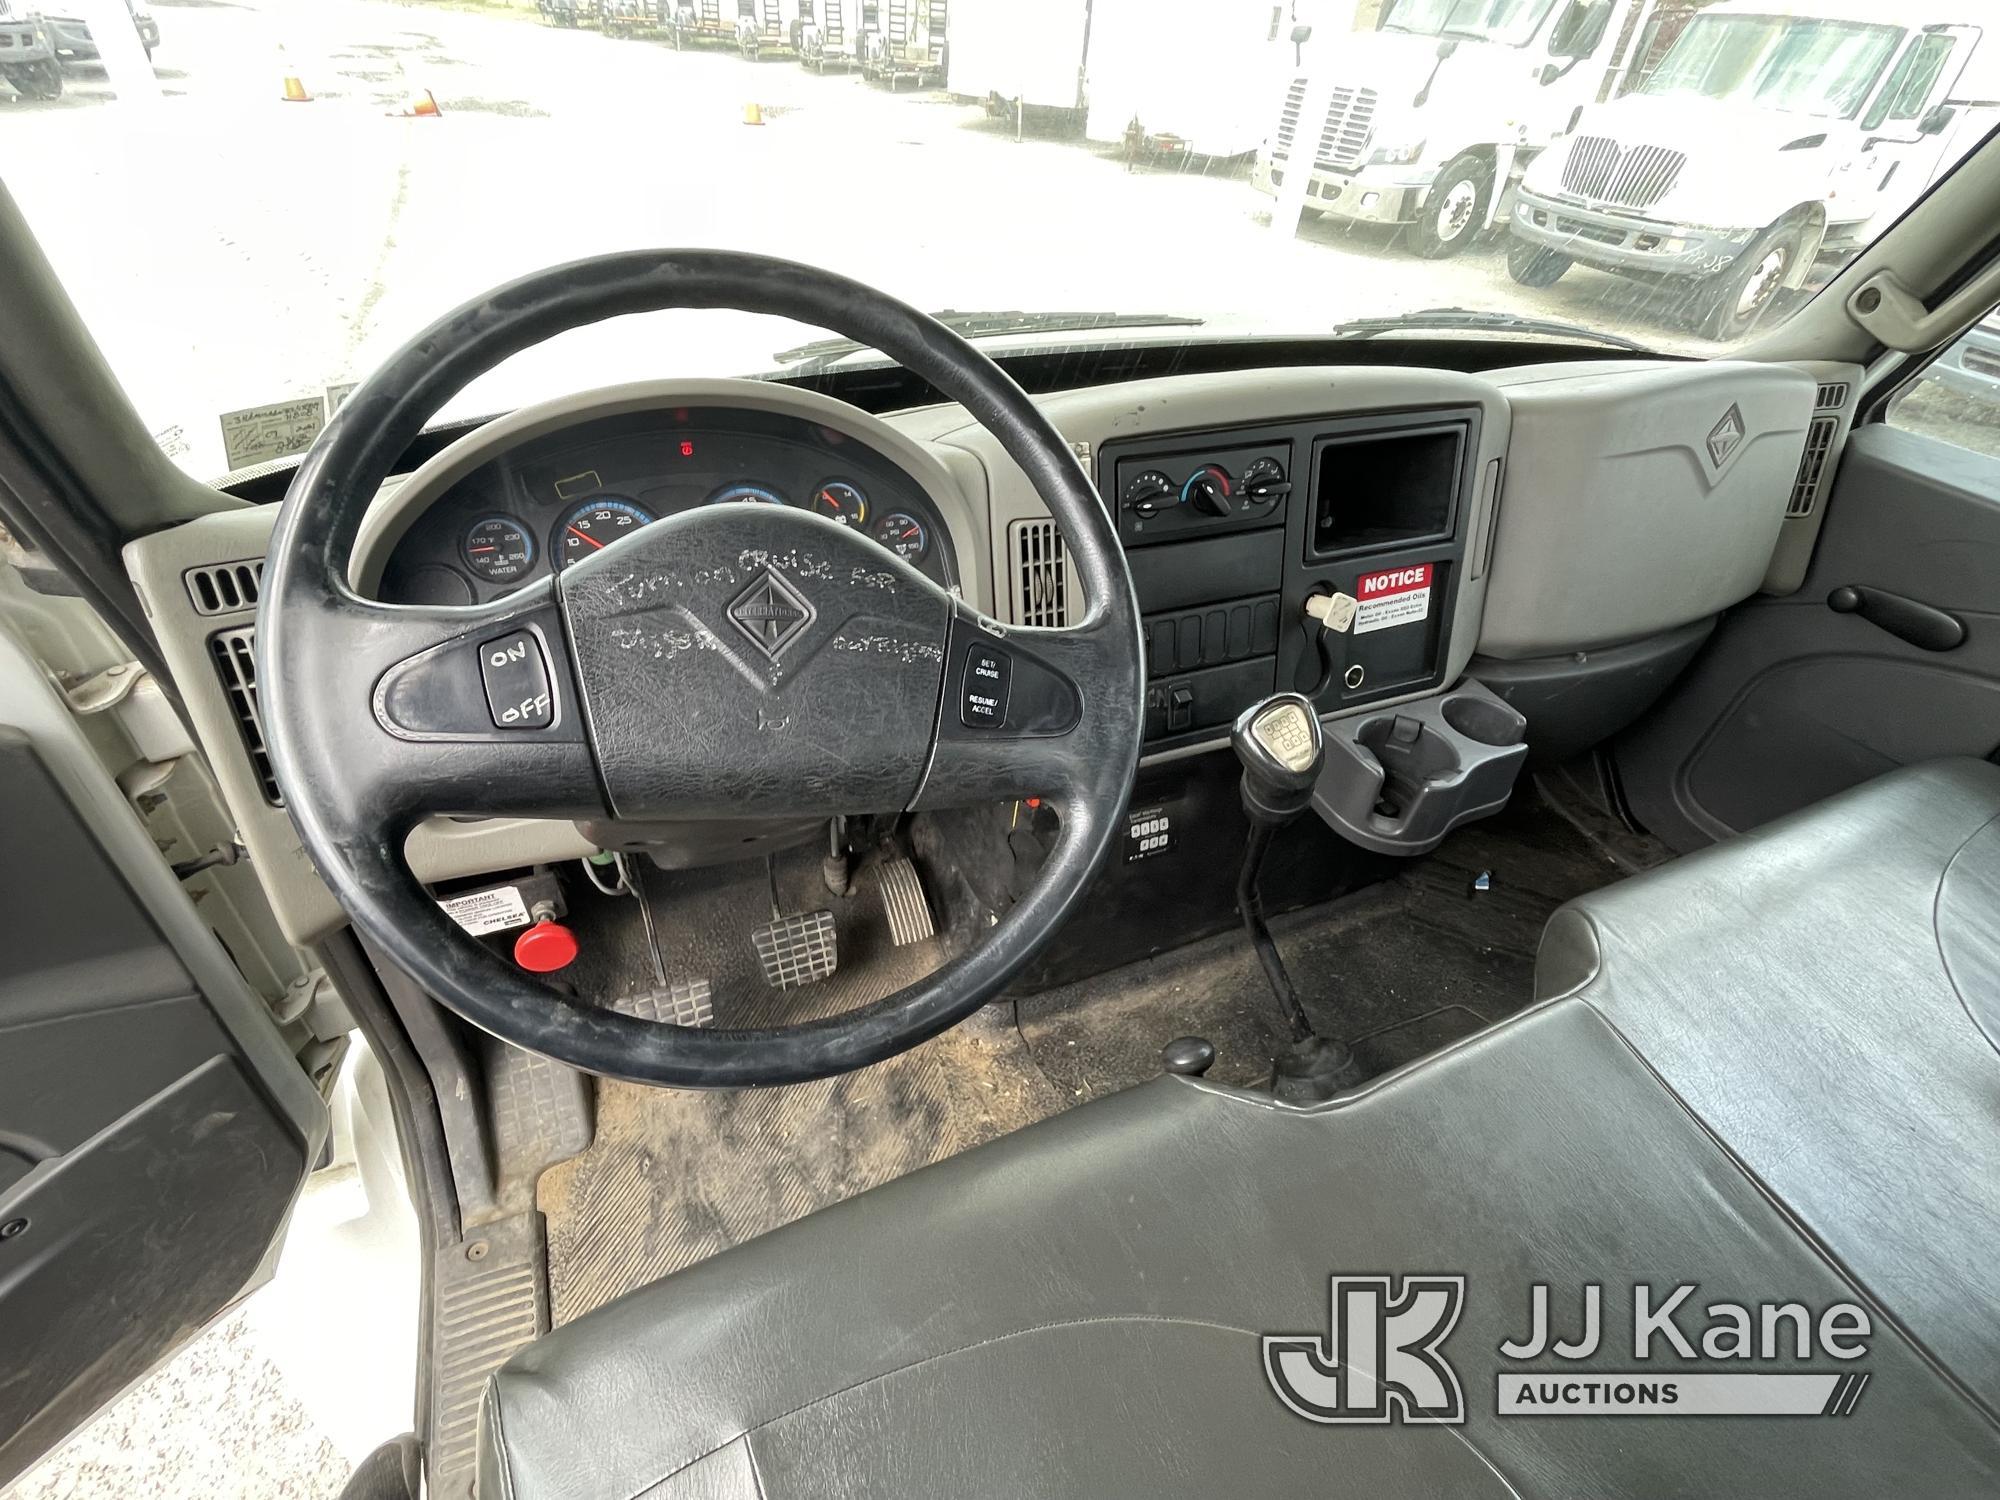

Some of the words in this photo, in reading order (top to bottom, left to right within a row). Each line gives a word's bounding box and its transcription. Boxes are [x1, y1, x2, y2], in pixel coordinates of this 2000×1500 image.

[595, 511, 611, 520] 20
[616, 516, 632, 525] 25
[577, 520, 591, 529] 15
[567, 537, 580, 547] 10
[488, 566, 518, 576] WATER
[1364, 567, 1425, 593] NOTICE
[1359, 595, 1411, 611] Recommended
[490, 641, 527, 668] ON
[976, 668, 999, 679] CRUISE
[501, 692, 551, 723] OFF
[972, 705, 993, 715] ACCEL
[446, 894, 495, 908] IMPORTANT
